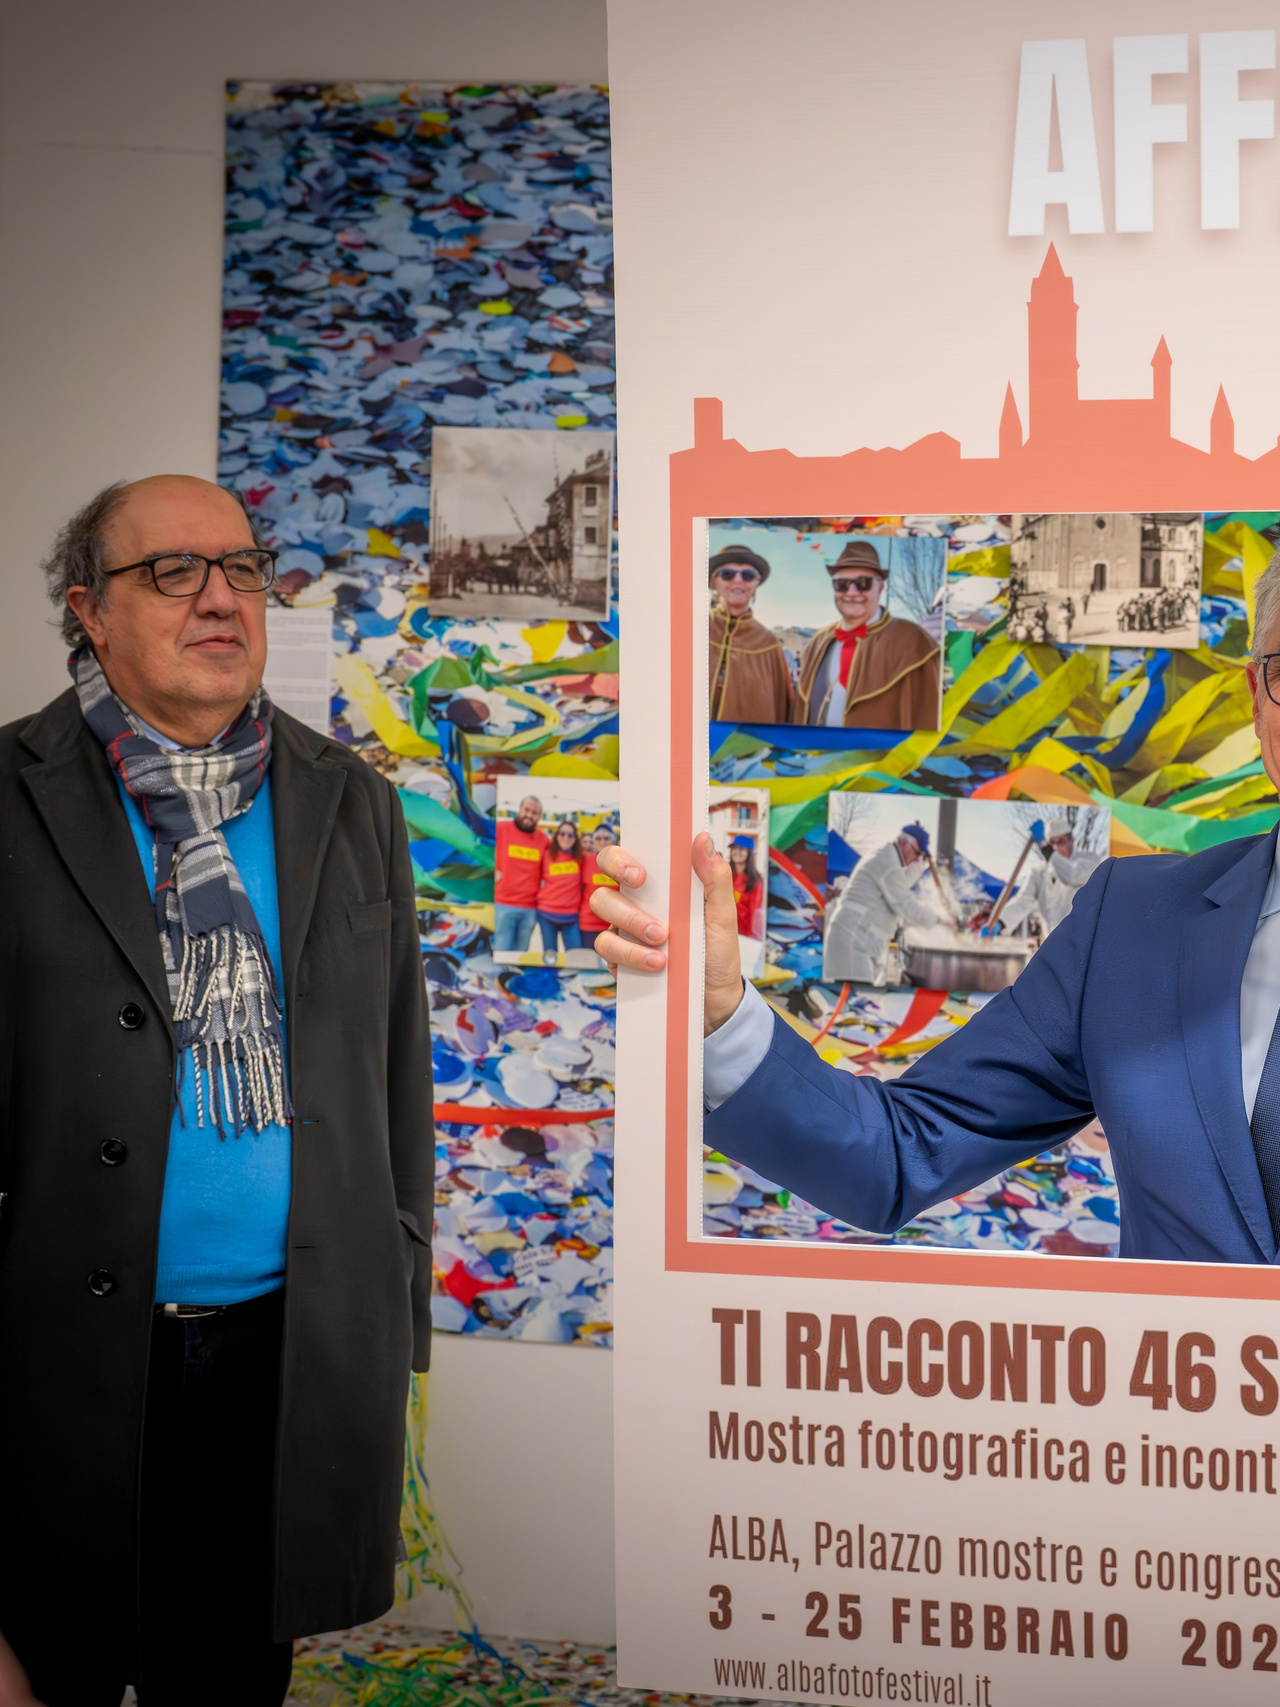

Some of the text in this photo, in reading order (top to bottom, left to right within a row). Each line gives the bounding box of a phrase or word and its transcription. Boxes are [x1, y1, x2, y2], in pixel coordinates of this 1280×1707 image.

[711, 1306, 762, 1388] TI
[785, 1311, 1107, 1408] RACCONTO
[1128, 1329, 1218, 1414] 46
[708, 1409, 846, 1468] Mostra
[857, 1419, 1091, 1484] fotografica
[1104, 1441, 1127, 1486] e
[708, 1513, 801, 1574] ALBA,
[814, 1520, 943, 1576] Palazzo
[957, 1535, 1084, 1586] mostre
[1099, 1546, 1118, 1588] e
[708, 1583, 734, 1631] 3
[760, 1612, 777, 1622] -
[803, 1590, 864, 1641] 25
[891, 1596, 1130, 1662] FEBBRAIO
[713, 1656, 993, 1707] www.albafotofestival.it
